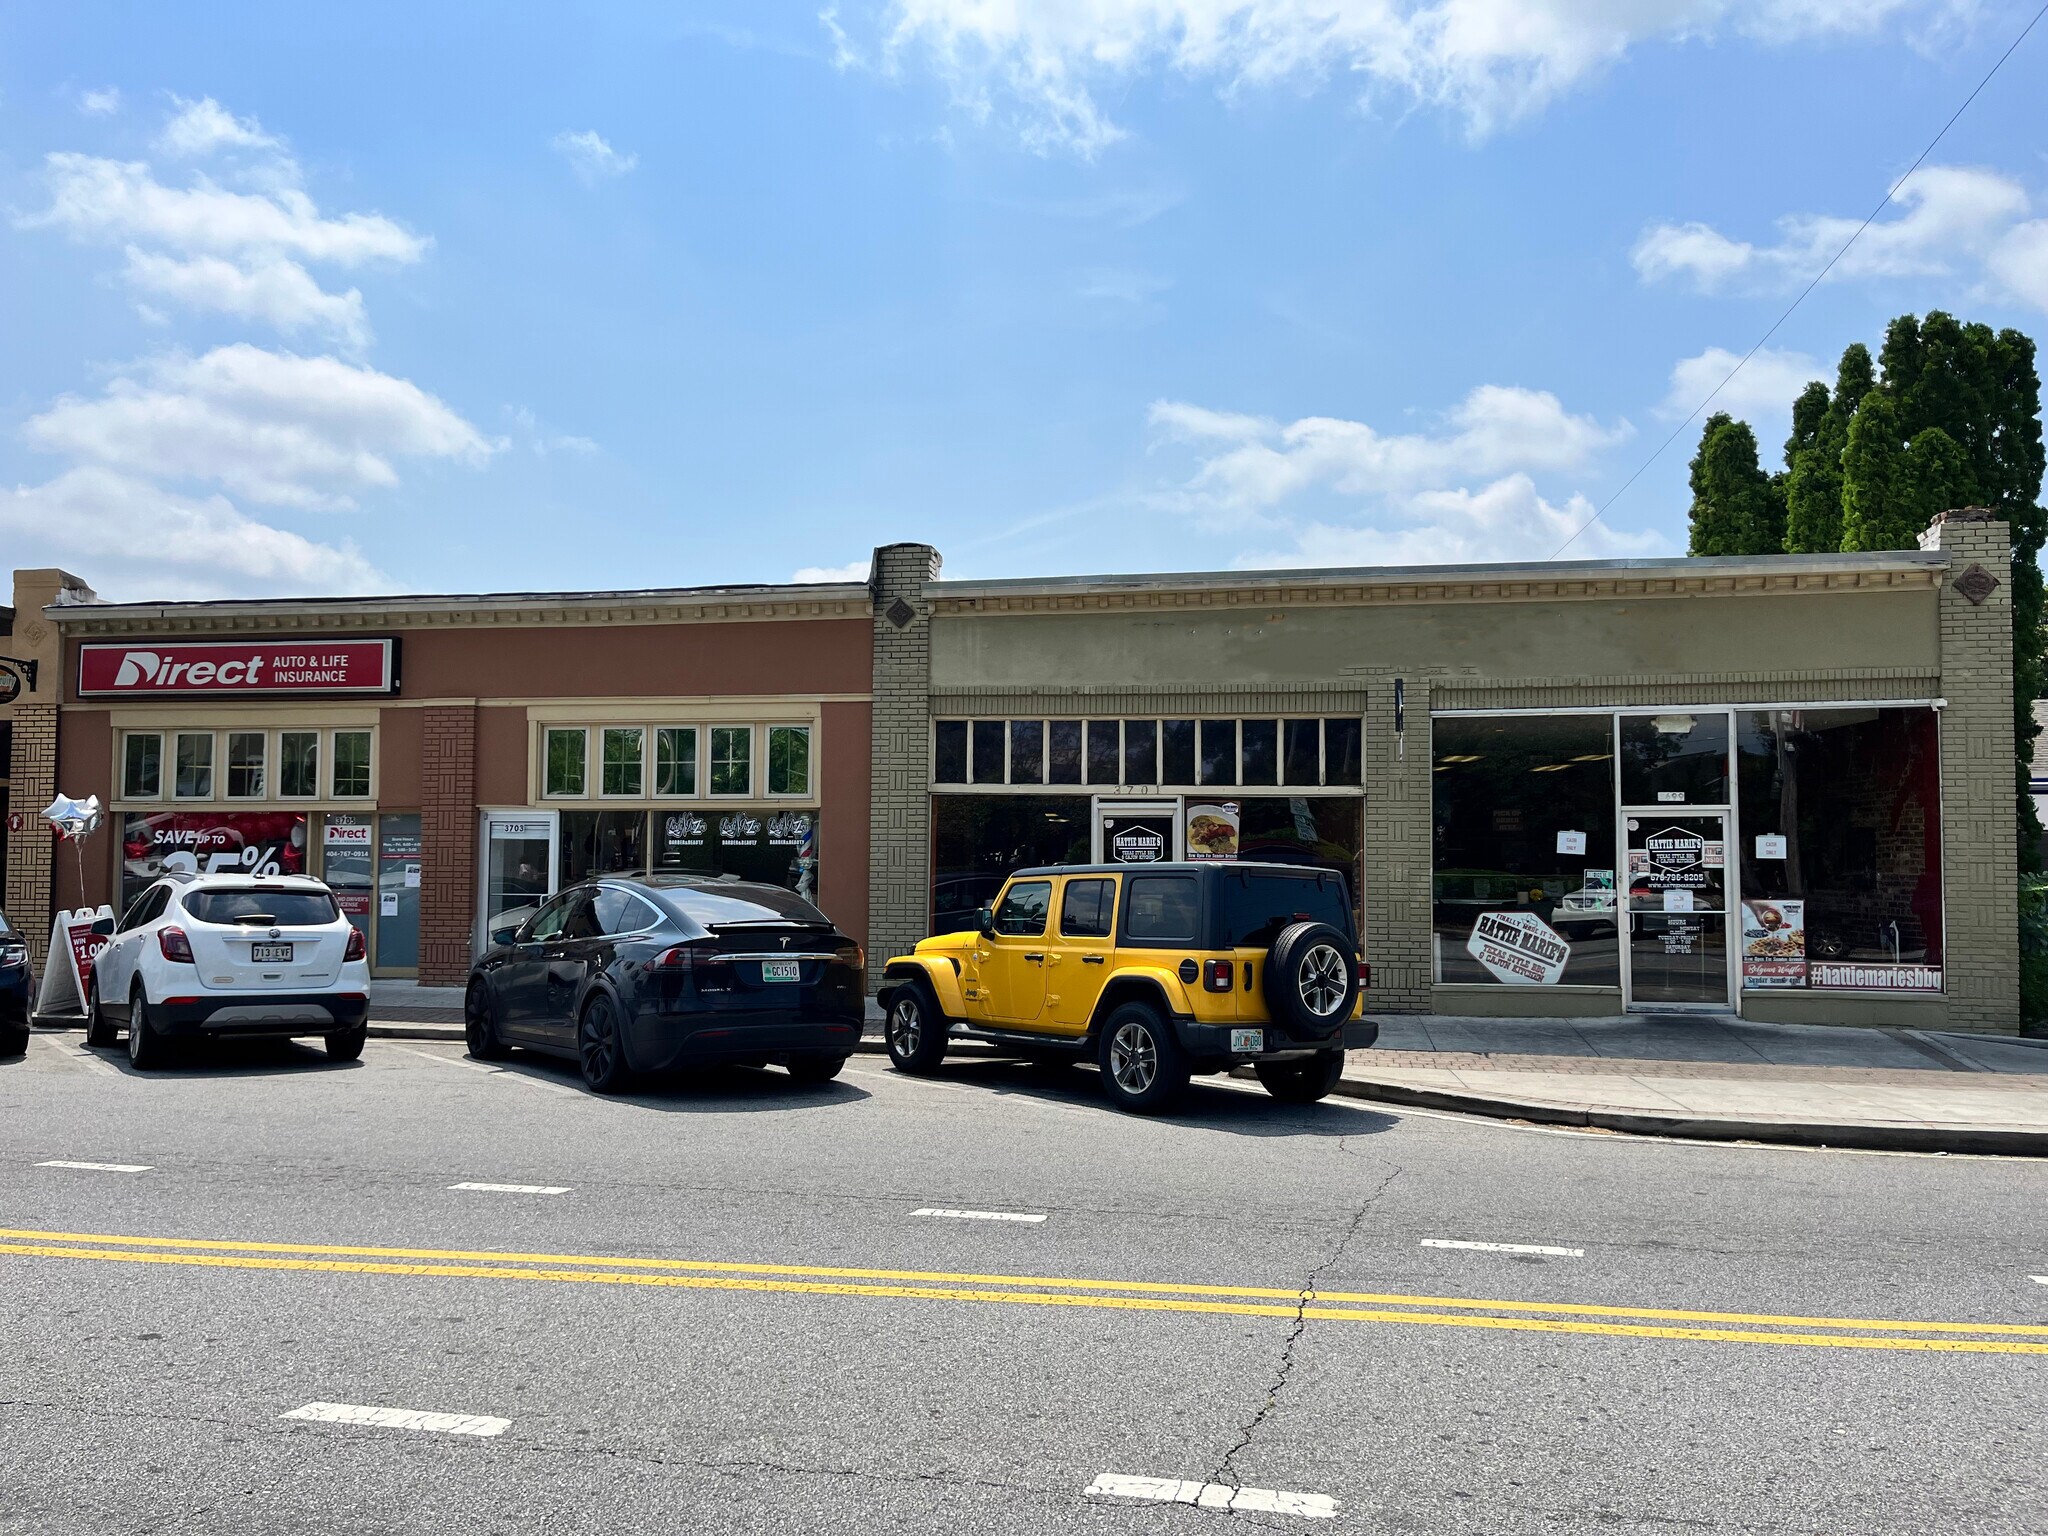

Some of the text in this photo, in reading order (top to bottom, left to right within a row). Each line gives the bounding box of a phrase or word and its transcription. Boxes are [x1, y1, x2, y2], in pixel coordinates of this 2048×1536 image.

[272, 655, 349, 667] AUTO & LIFE
[113, 651, 264, 686] Direct
[274, 670, 347, 682] INSURANCE
[1113, 785, 1160, 795] 3701
[335, 816, 356, 825] 3705
[329, 827, 367, 838] Direct
[504, 824, 524, 832] 3703
[153, 830, 226, 844] SAVE UP TO
[1649, 838, 1702, 850] HATTIE MARIE'S
[1496, 914, 1521, 926] FINALLY
[1477, 916, 1522, 946] HATTIE
[73, 938, 86, 946] WIN
[254, 948, 291, 957] 713 EVF
[1483, 944, 1546, 974] TEXAS STYLE BBQ
[772, 966, 797, 976] GC1510
[1485, 954, 1511, 970] CAJUN
[1512, 964, 1545, 983] KITCHEN
[1748, 963, 1803, 976] Belgian Waffles
[1811, 966, 1942, 990] #hattiemariesbbq
